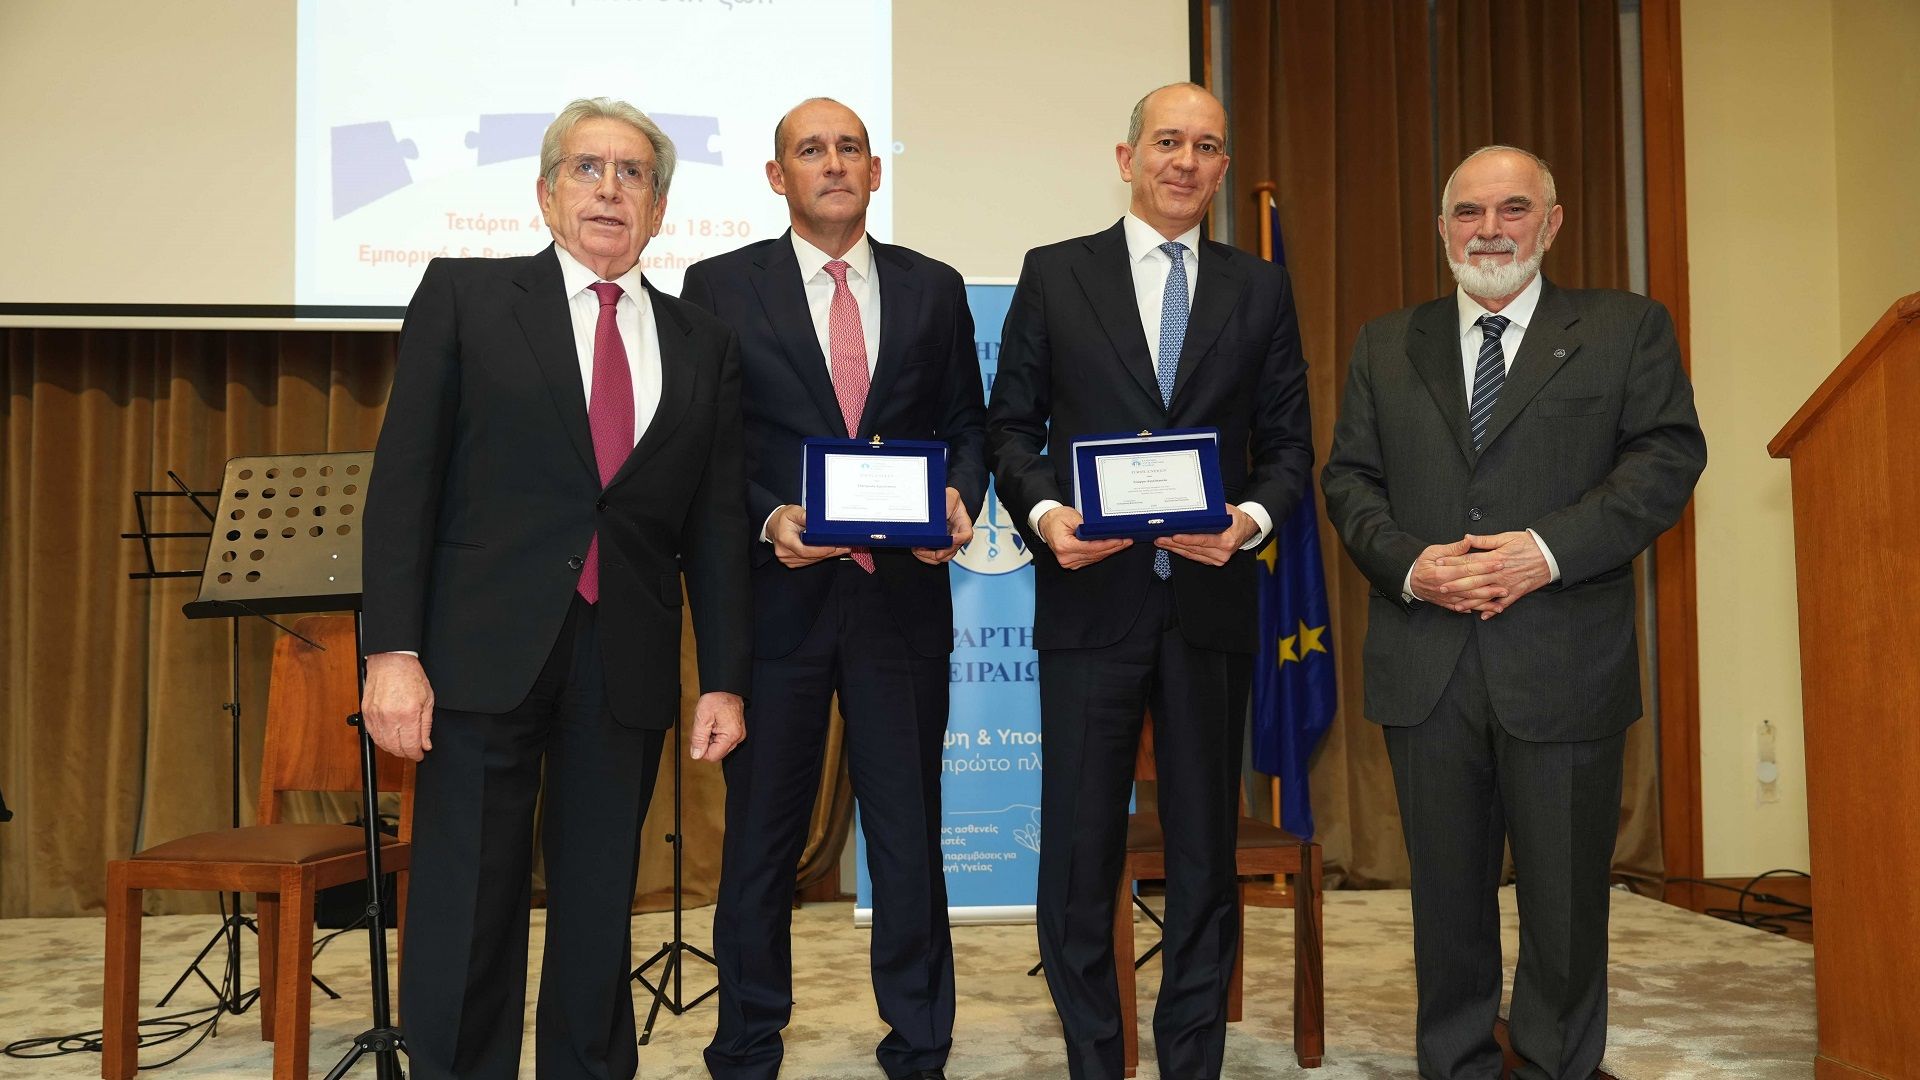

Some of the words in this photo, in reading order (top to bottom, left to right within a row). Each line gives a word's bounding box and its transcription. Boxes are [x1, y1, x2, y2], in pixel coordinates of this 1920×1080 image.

[445, 212, 520, 236] Τετάρτη
[528, 215, 541, 232] 4
[687, 219, 752, 238] 18:30
[977, 728, 992, 746] &
[996, 728, 1042, 746] Υπο
[942, 752, 1011, 776] πρώτο
[954, 823, 999, 835] ασθενείς
[944, 850, 1003, 862] παρεμβάσεις
[1003, 851, 1017, 861] για
[961, 862, 993, 873] Υγείας
